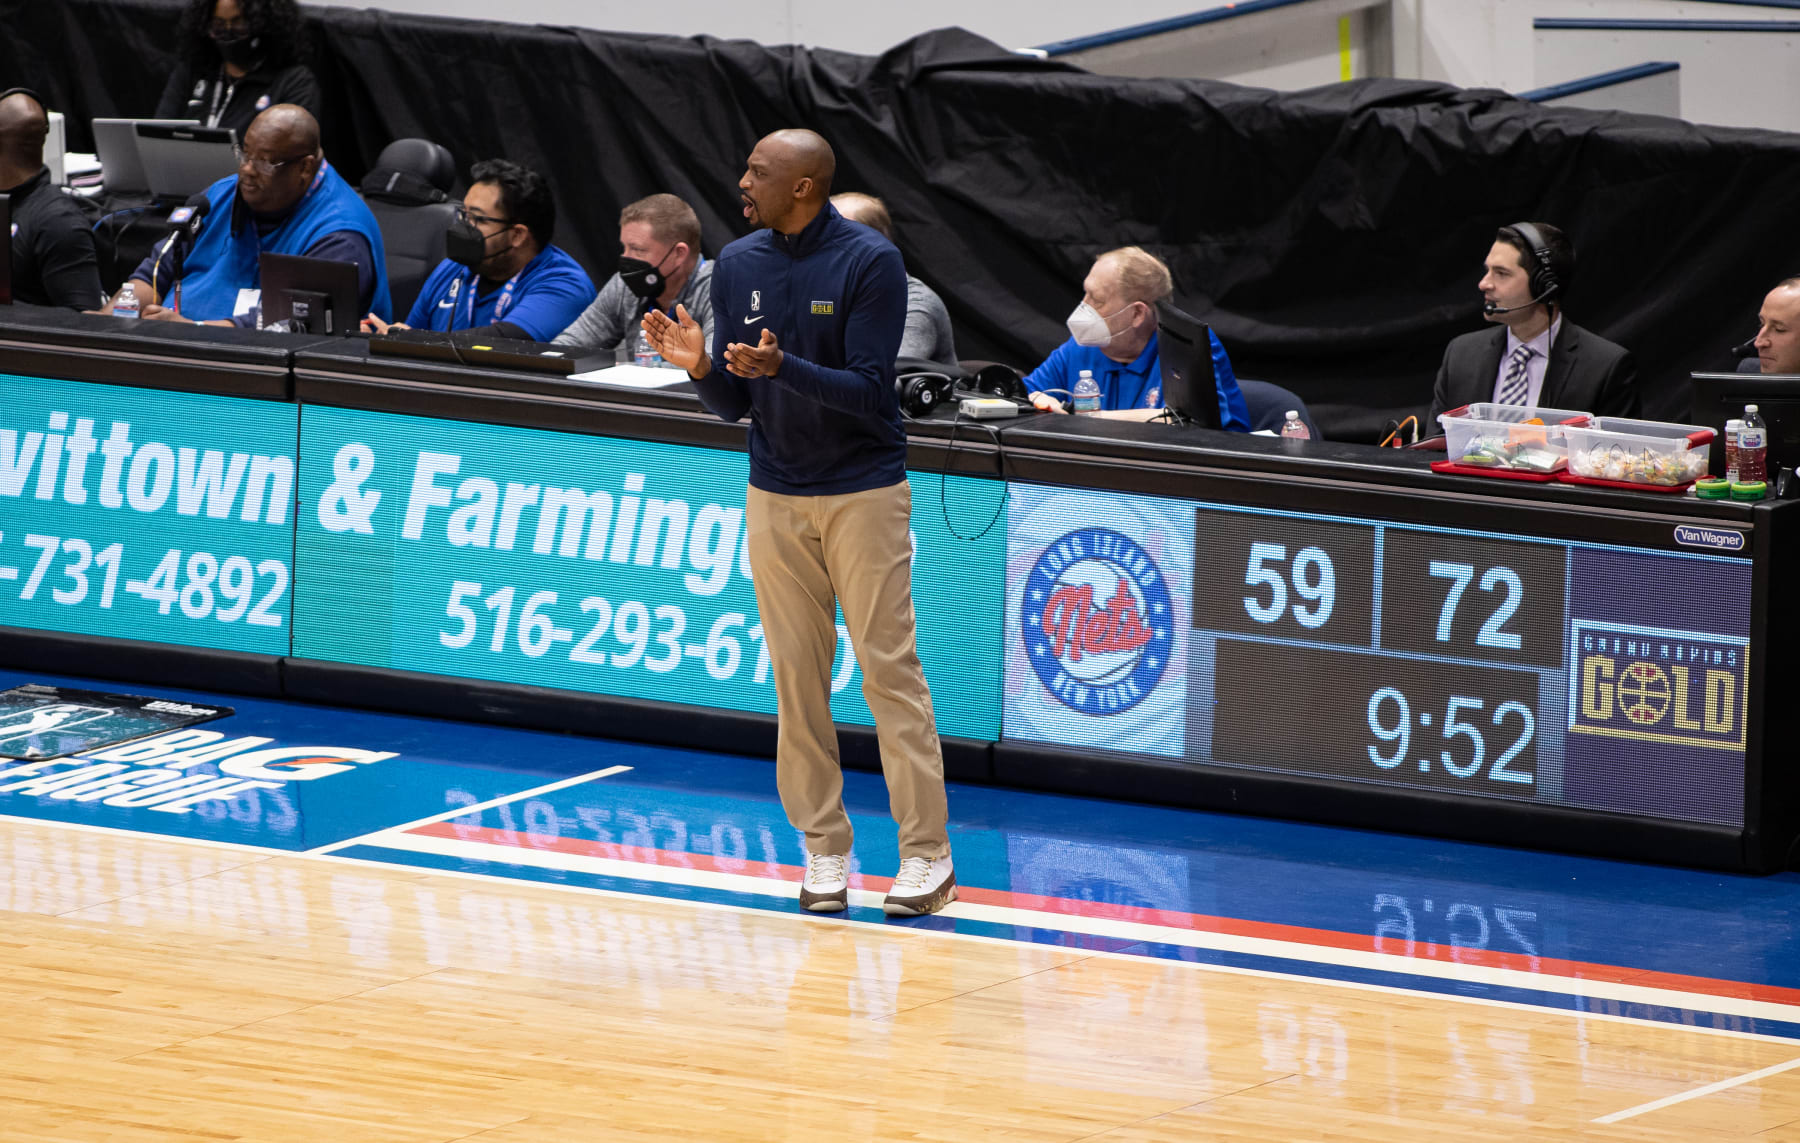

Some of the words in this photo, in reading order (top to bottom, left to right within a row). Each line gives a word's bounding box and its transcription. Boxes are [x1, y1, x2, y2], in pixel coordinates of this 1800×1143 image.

[317, 442, 382, 534] &
[0, 530, 289, 627] -731-4892
[1039, 537, 1083, 579] LONG
[1094, 534, 1157, 587] ISLAND
[1680, 529, 1700, 542] Van
[1700, 531, 1740, 547] Wagner
[1042, 579, 1155, 661] Nets
[1243, 542, 1335, 629] 59
[1429, 561, 1523, 649] 72
[438, 580, 857, 695] 516-293-61
[1052, 671, 1090, 705] NEW
[1367, 687, 1535, 784] 9:52
[0, 756, 287, 814] EAGUE
